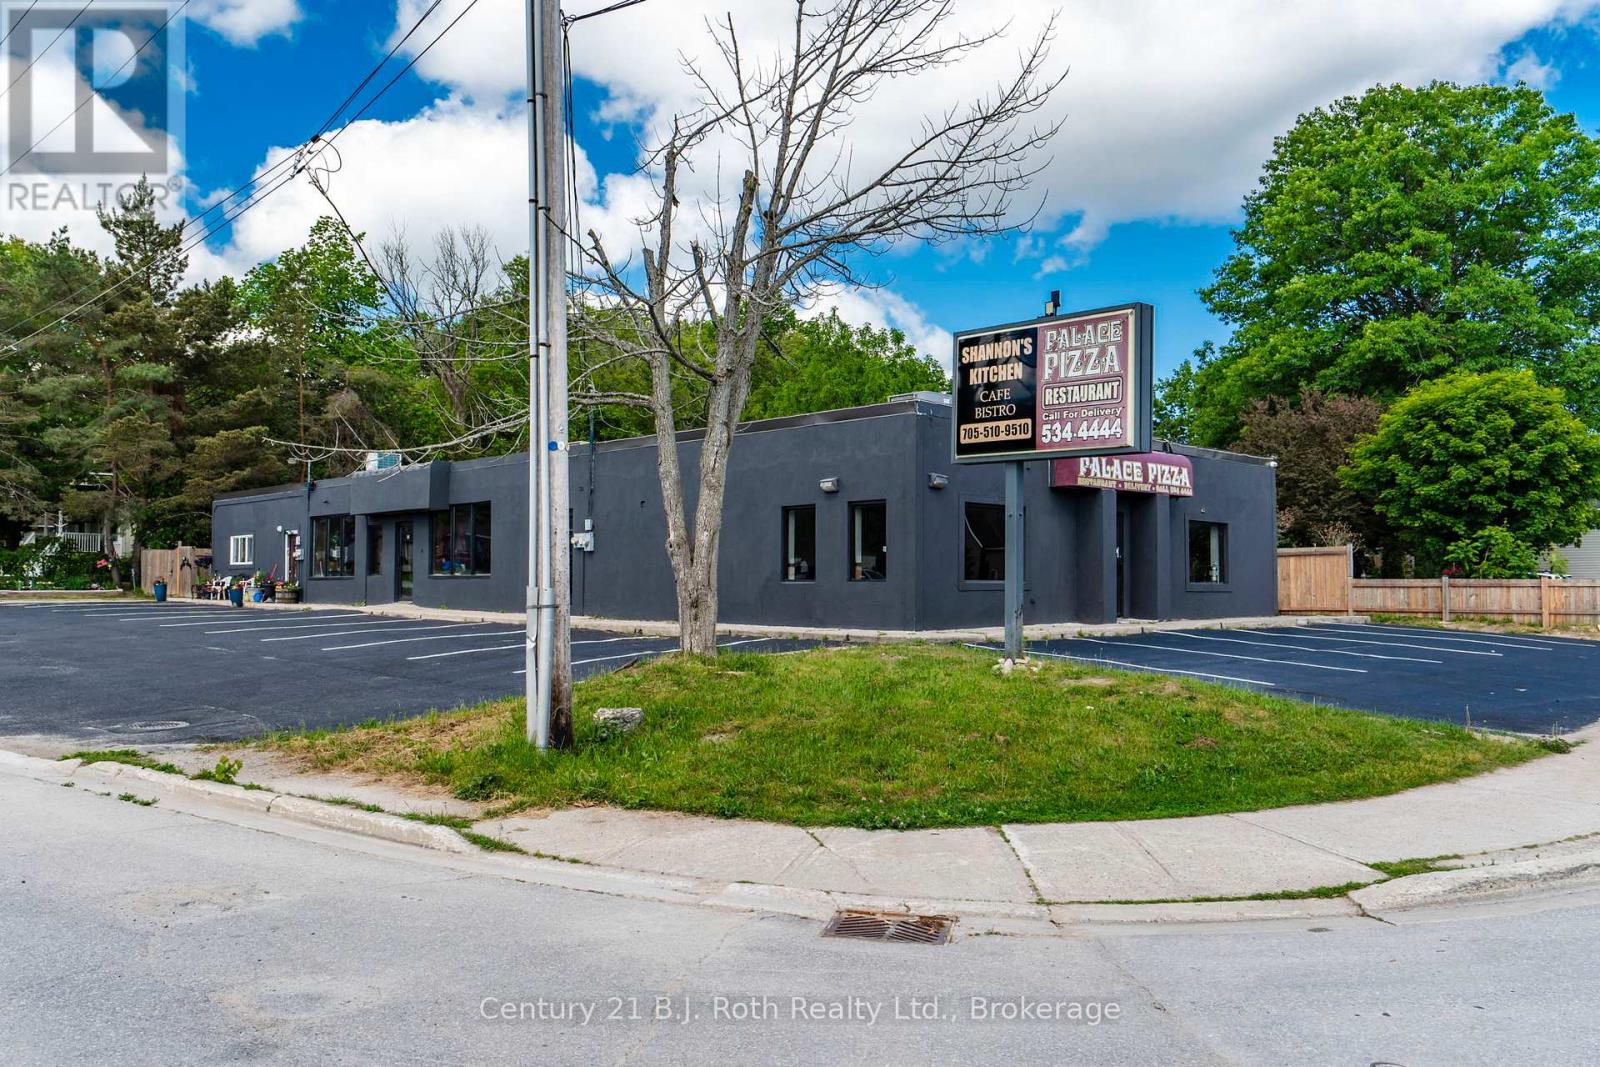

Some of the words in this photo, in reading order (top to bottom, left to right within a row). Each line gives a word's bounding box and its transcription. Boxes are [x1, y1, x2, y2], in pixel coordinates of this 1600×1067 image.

[1045, 320, 1123, 351] PALACE
[961, 337, 1033, 364] SHANNON'S
[969, 362, 1024, 386] KITCHEN
[1042, 345, 1122, 382] PIZZA
[979, 387, 1012, 404] CAFE
[1044, 381, 1120, 406] RESTAURANT
[974, 404, 1017, 420] BISTRO
[1042, 411, 1060, 421] Call
[1063, 410, 1078, 419] For
[1081, 406, 1122, 419] Delivery
[962, 422, 1030, 440] 705-510-9510
[1079, 456, 1143, 482] PALACE
[1147, 463, 1191, 487] PIZZA
